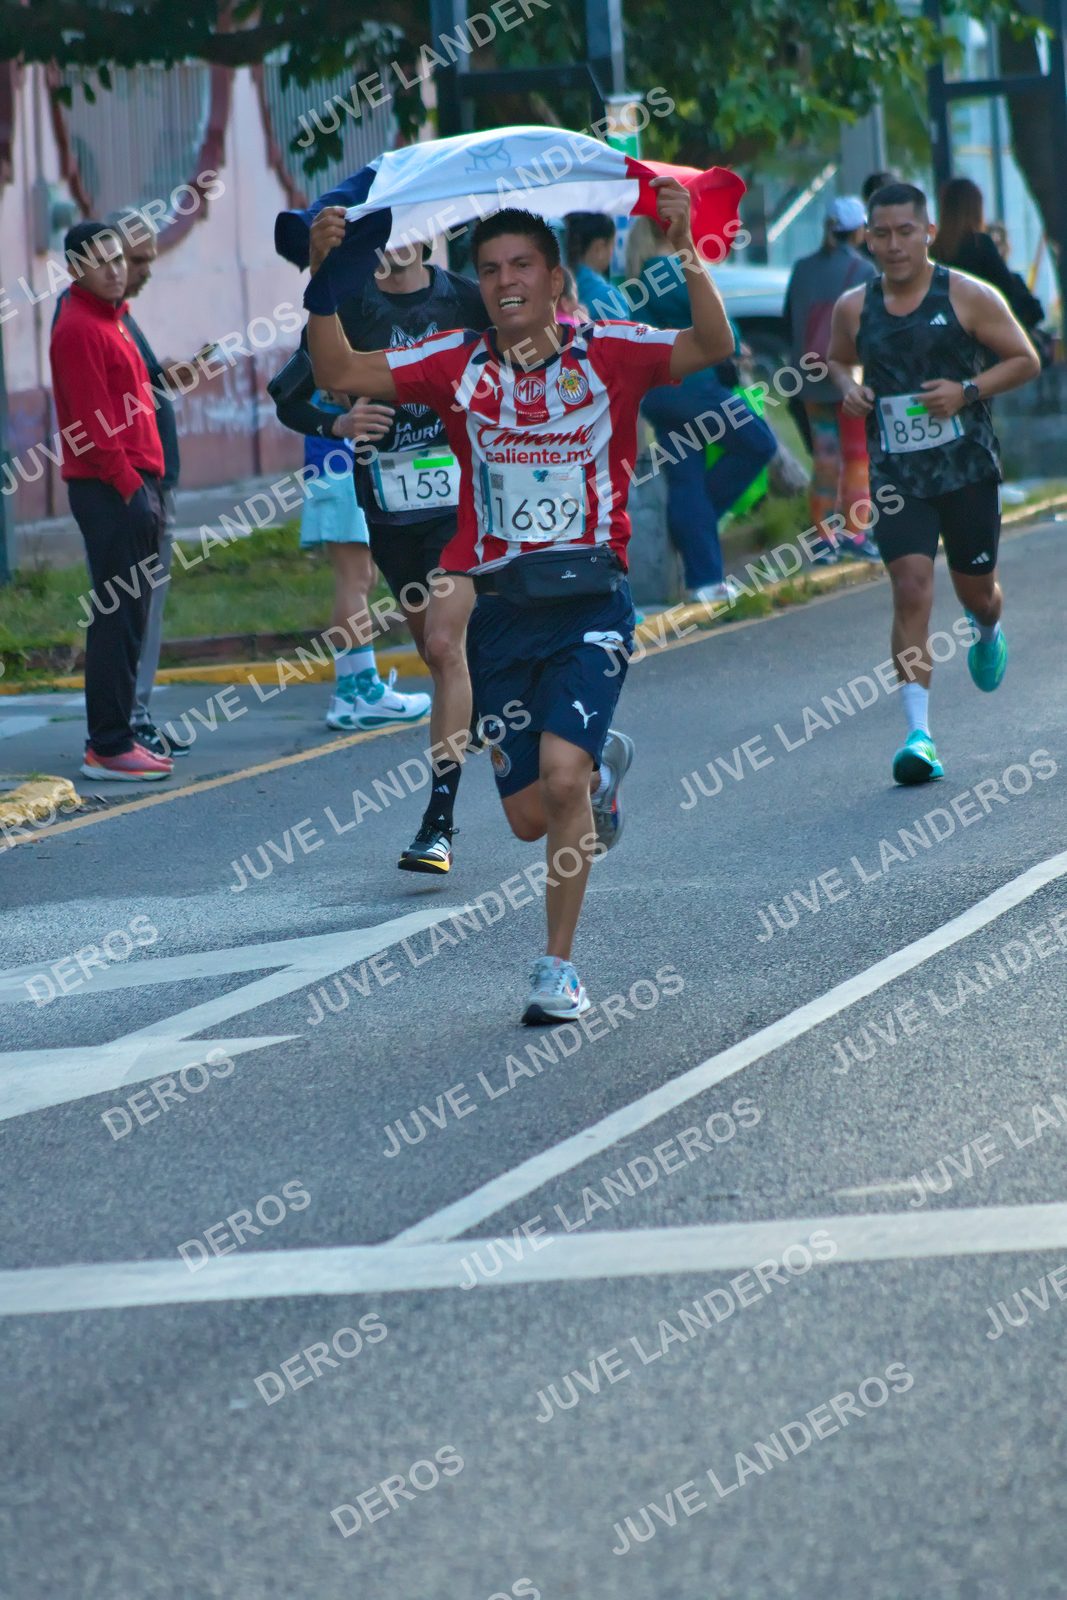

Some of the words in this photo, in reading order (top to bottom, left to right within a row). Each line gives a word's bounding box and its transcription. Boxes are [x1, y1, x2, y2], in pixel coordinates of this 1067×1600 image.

[396, 423, 412, 433] LA
[893, 416, 943, 444] 855
[485, 446, 593, 464] caliente.mx
[397, 470, 451, 501] 153
[495, 498, 580, 531] 1639
